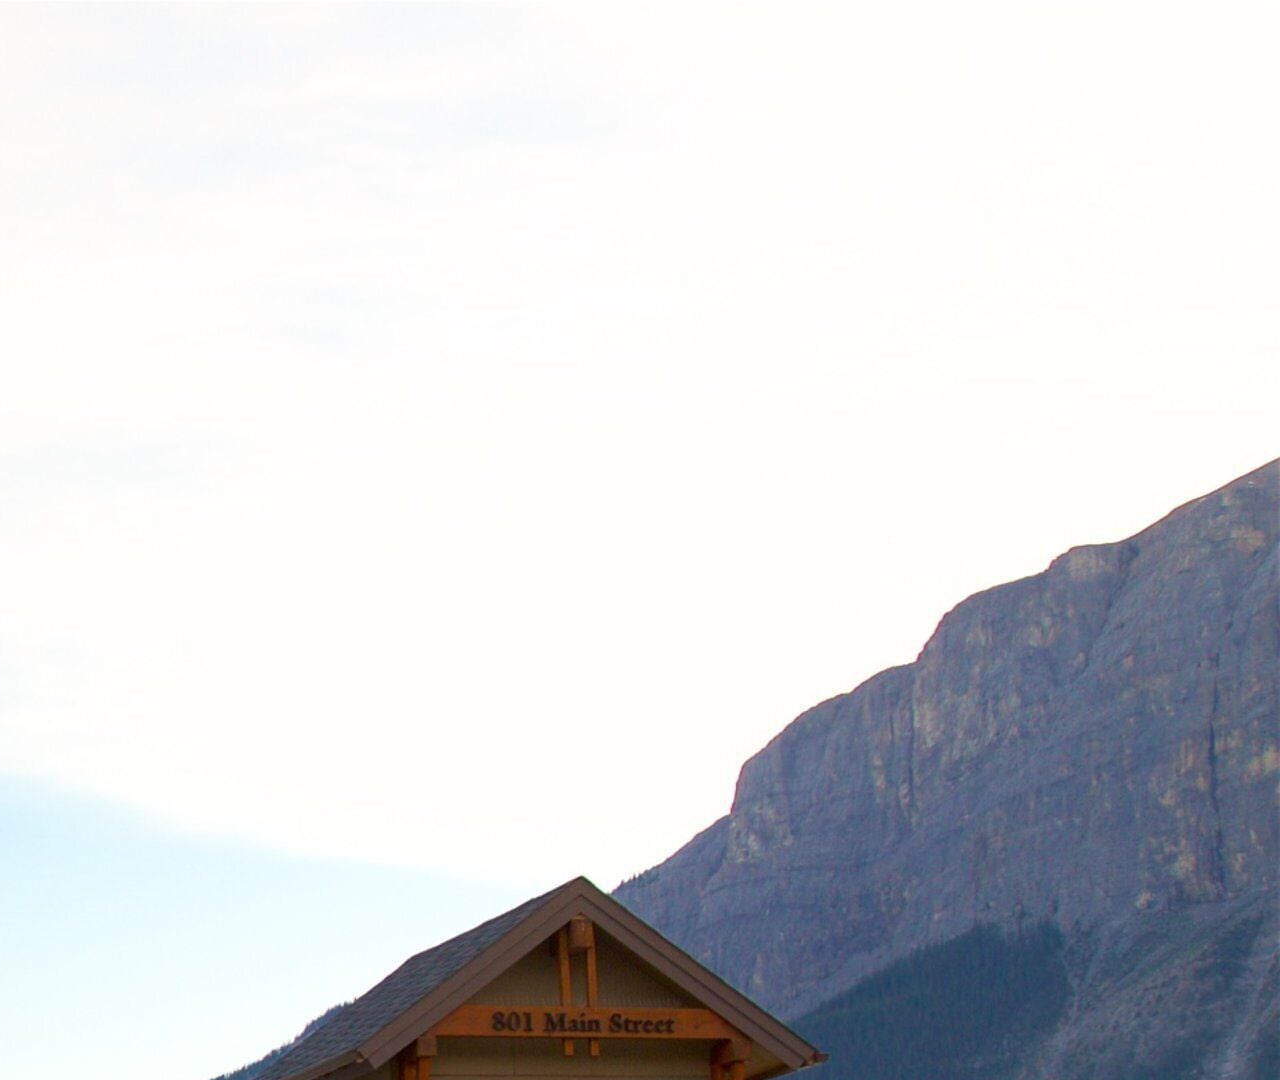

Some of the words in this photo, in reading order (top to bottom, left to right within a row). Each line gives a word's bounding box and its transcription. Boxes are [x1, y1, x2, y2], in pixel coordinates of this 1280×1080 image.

[491, 1011, 533, 1032] 801
[542, 1012, 601, 1033] Main
[608, 1013, 676, 1034] Street
